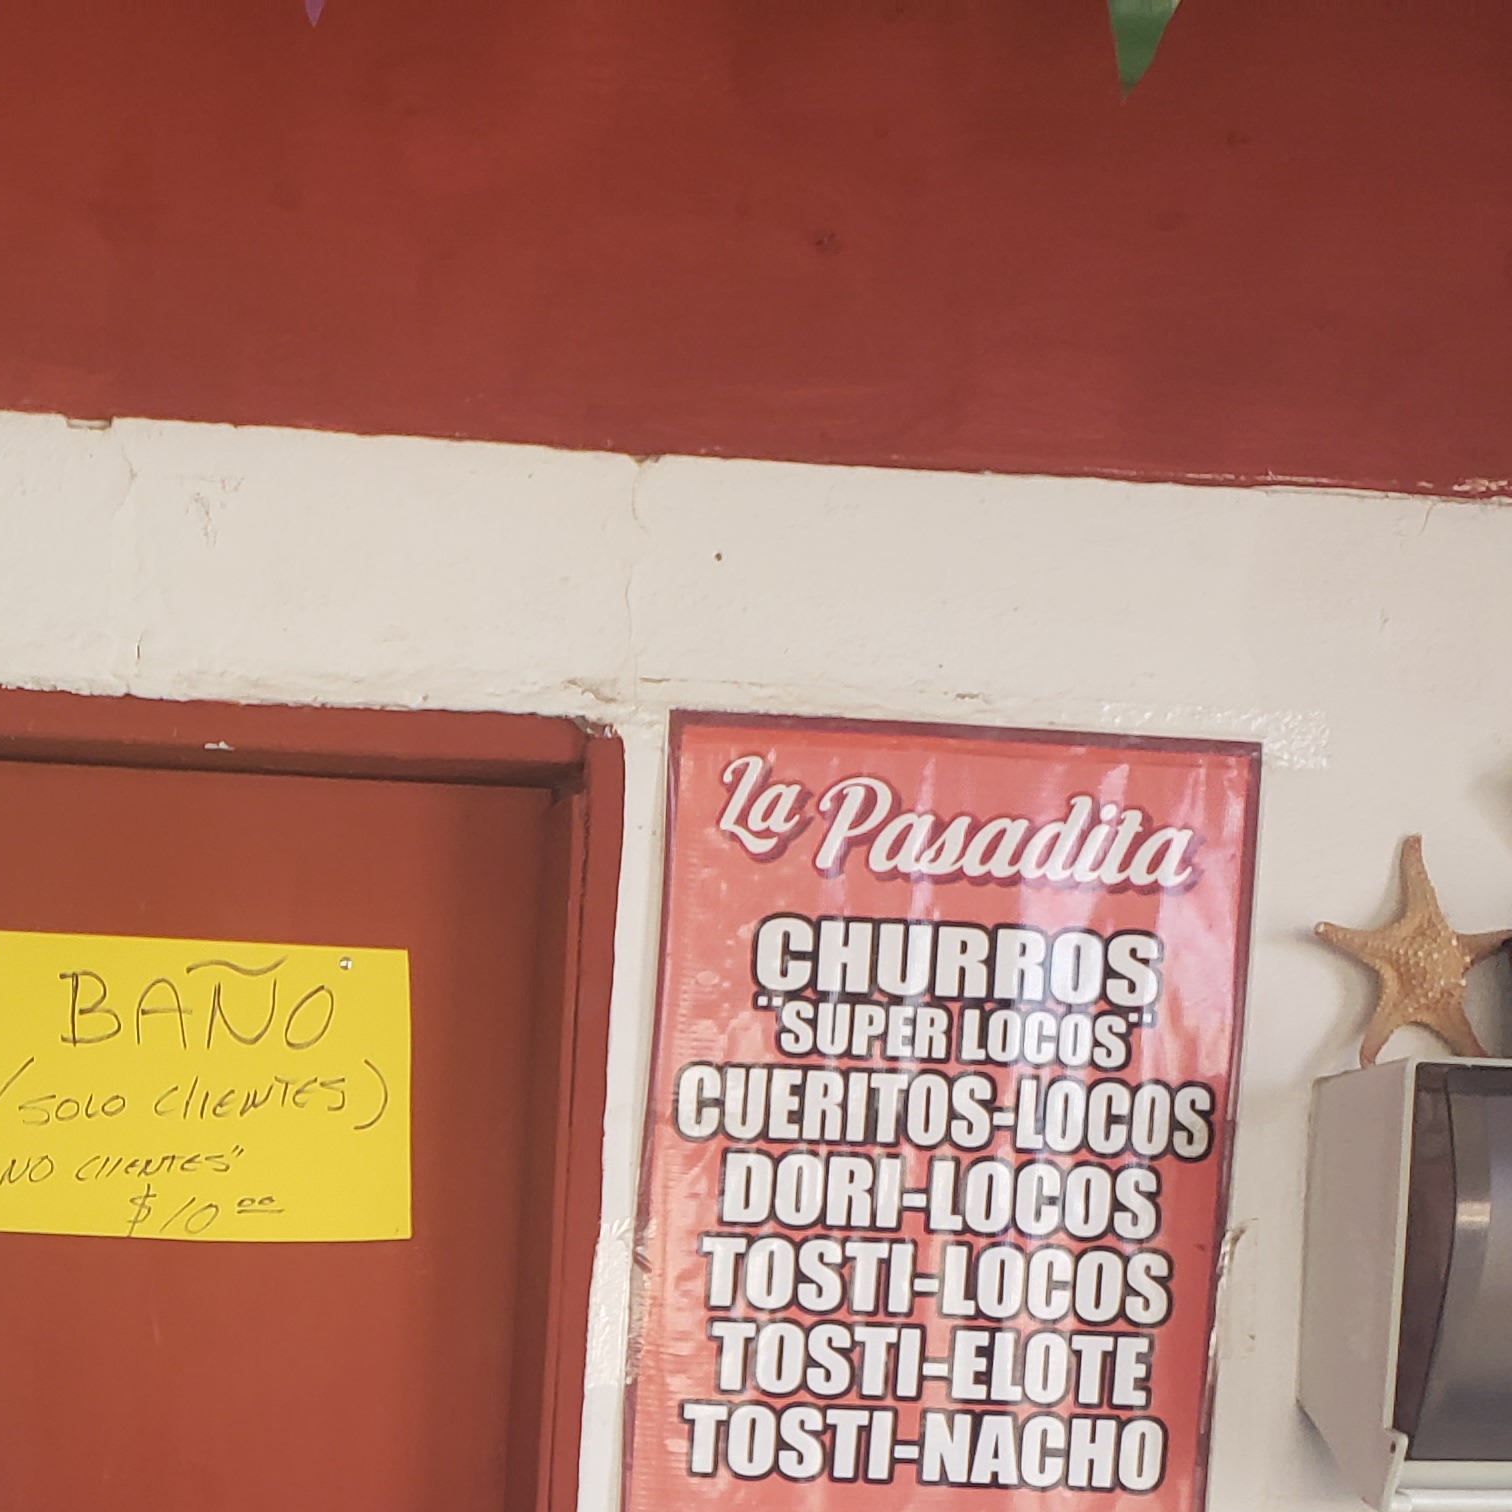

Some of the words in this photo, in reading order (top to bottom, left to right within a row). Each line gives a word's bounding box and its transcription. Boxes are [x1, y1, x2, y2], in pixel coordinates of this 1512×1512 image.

[718, 755, 804, 857] La
[813, 777, 1198, 888] Pasadita
[59, 954, 335, 1051] BAÑO
[751, 913, 1166, 1009] CHURROS
[675, 1061, 1217, 1163] CUERITOS-LOCOS
[717, 1149, 1162, 1243] DORI-LOCOS
[697, 1232, 1174, 1328] TOSTI-LOCOS
[708, 1317, 1153, 1408] TOSTI-ELOTE
[682, 1398, 1169, 1495] TOSTI-NACHO
